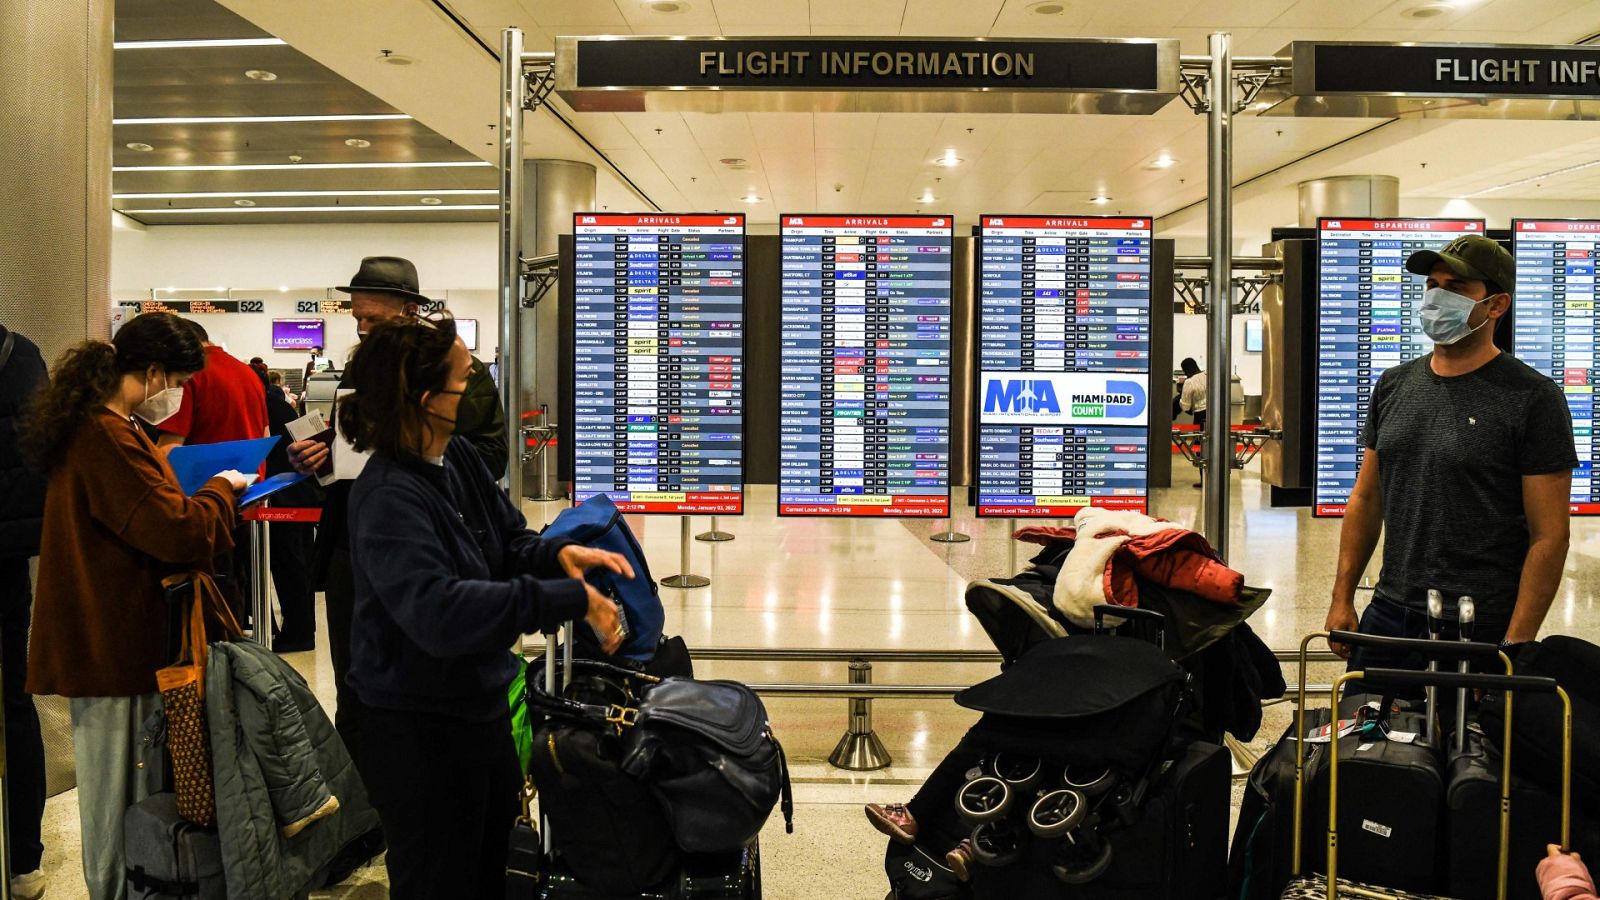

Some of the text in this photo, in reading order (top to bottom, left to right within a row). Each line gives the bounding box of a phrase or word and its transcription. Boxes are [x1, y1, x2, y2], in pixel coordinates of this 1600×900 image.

[700, 51, 1034, 76] FLIGHT INFORMATION
[1436, 59, 1600, 83] FLIGHT INF
[241, 301, 263, 312] 522
[297, 301, 318, 312] 521
[1072, 405, 1104, 416] COUNTY
